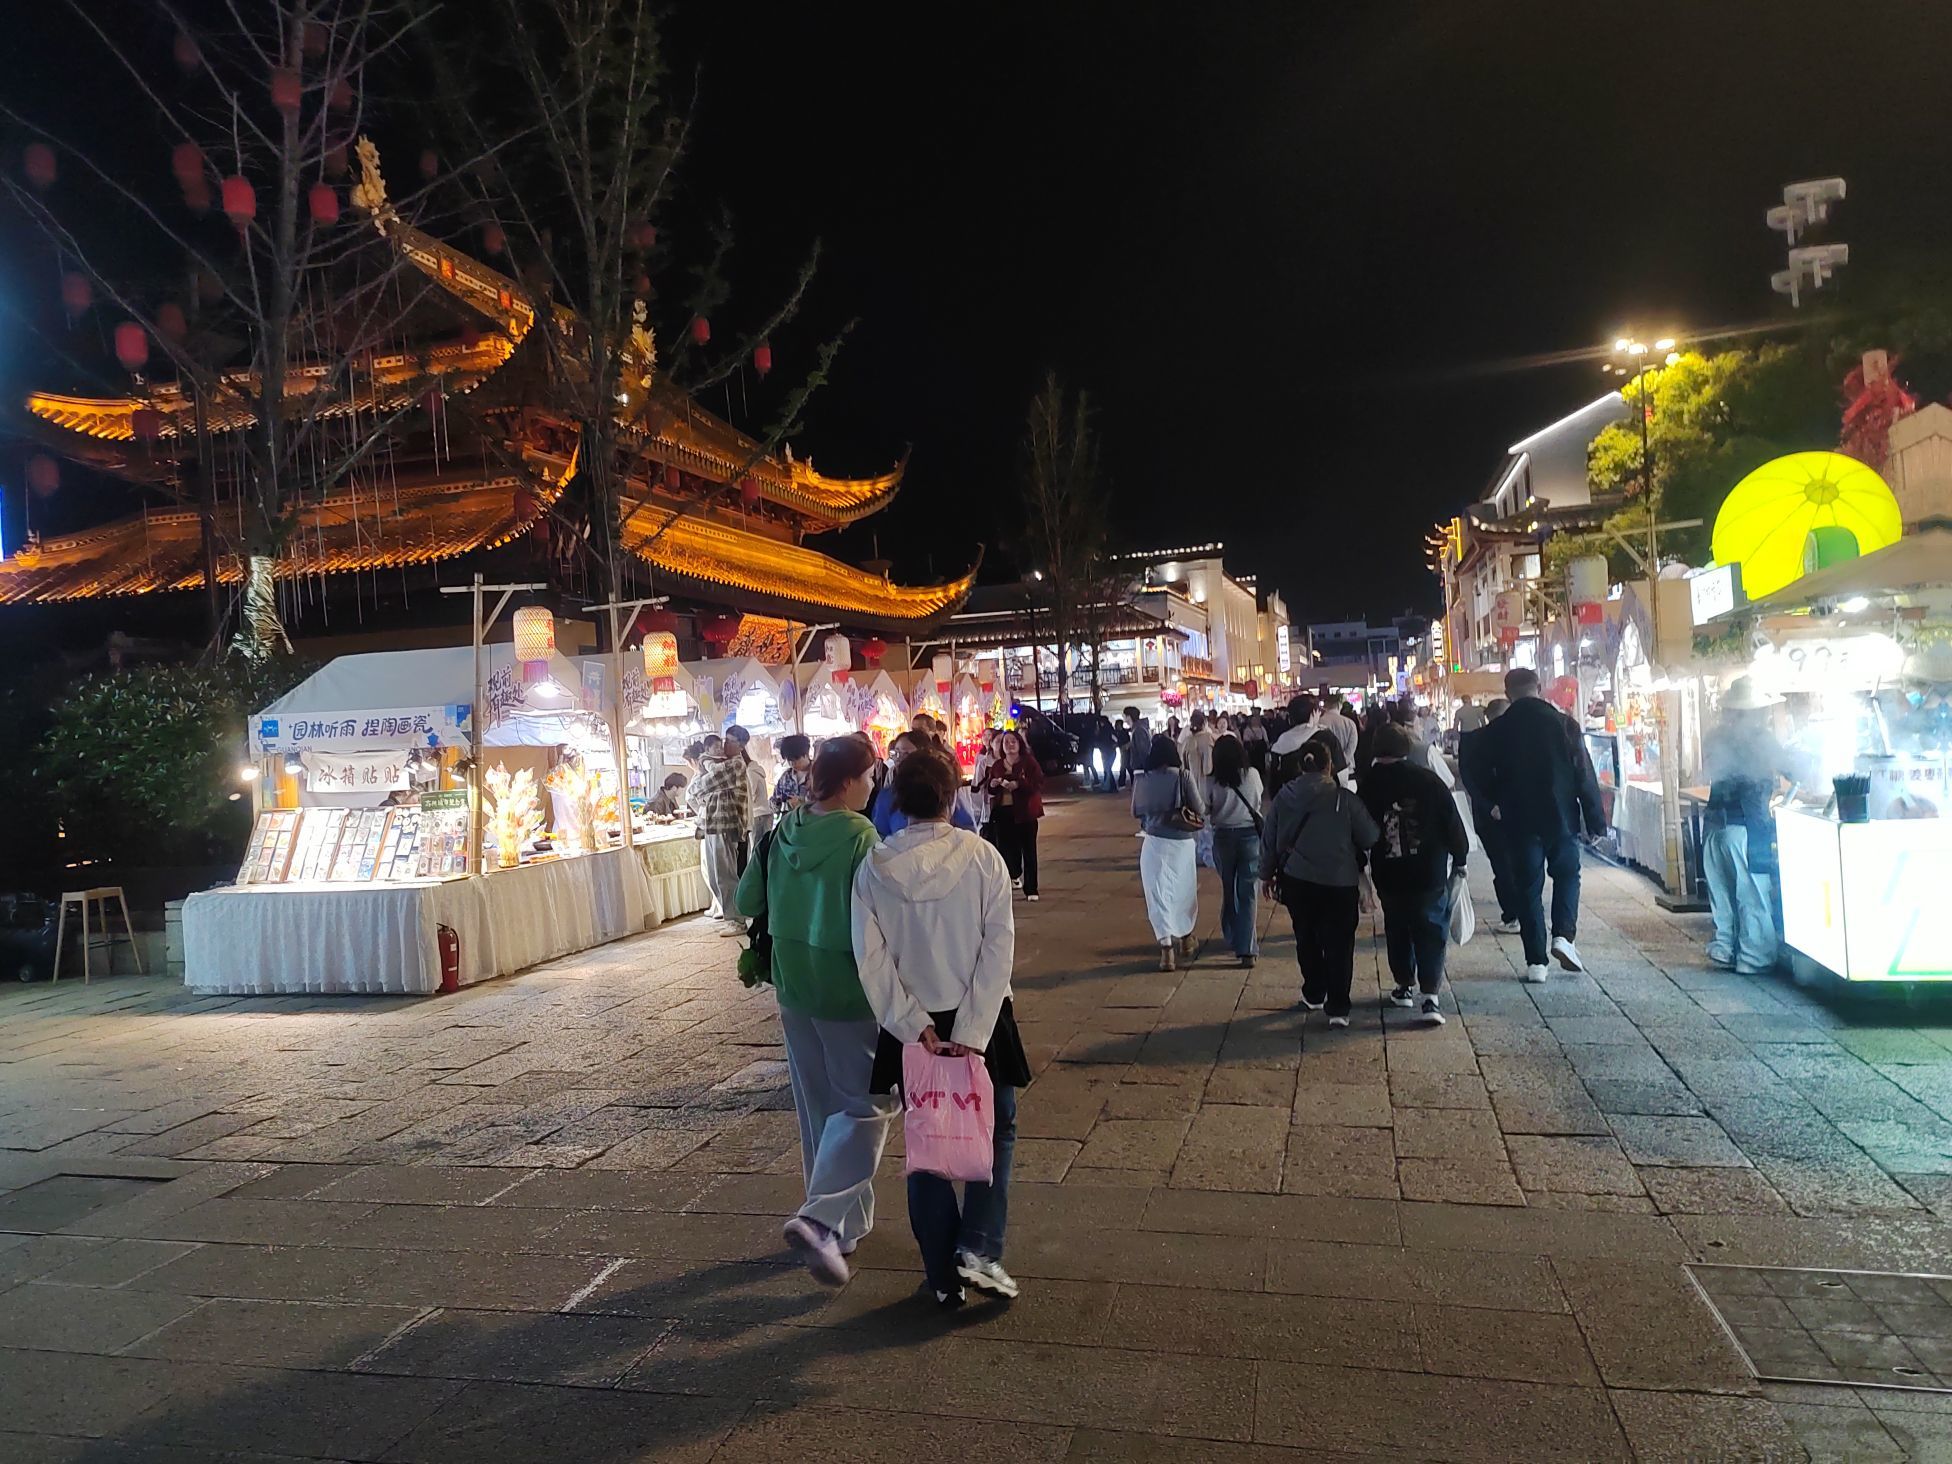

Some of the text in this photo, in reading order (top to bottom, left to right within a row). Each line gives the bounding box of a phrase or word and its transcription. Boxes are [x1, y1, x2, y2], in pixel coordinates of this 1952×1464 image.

[292, 714, 434, 741] 园林听雨 捏陶画瓷
[318, 764, 400, 786] 冰箱贴贴
